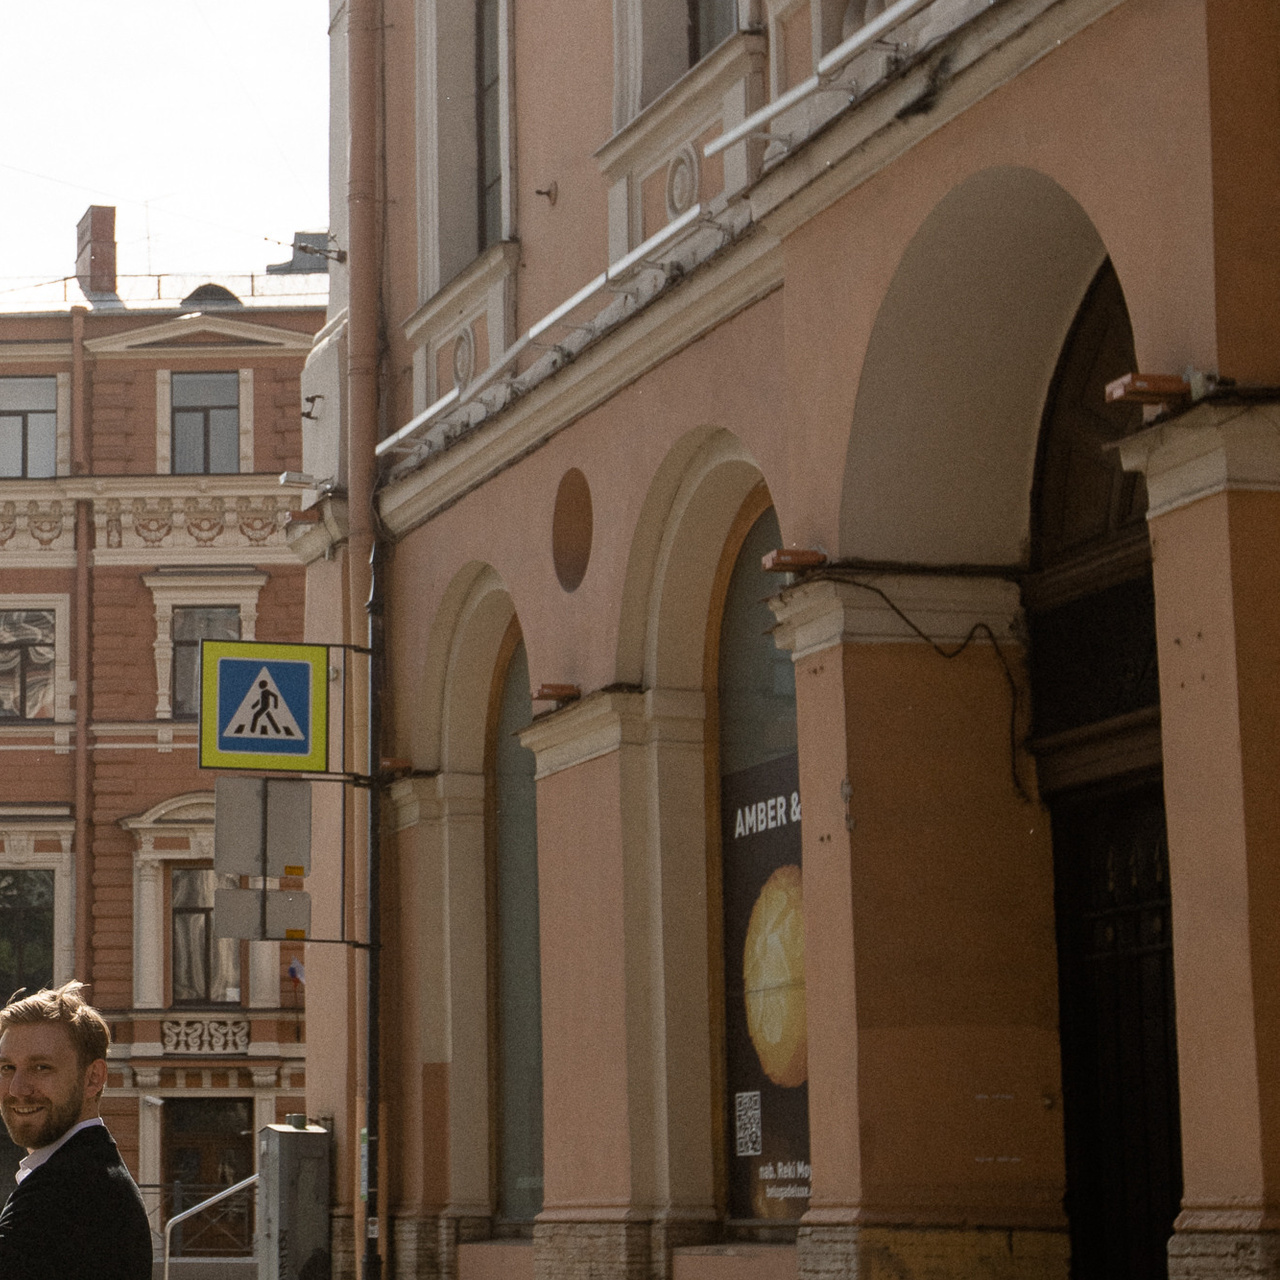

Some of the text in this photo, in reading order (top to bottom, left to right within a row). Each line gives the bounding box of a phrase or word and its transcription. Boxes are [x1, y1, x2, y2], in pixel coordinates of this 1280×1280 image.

[734, 791, 802, 839] AMBER &
[758, 1162, 776, 1179] nab.
[777, 1161, 796, 1179] Reki
